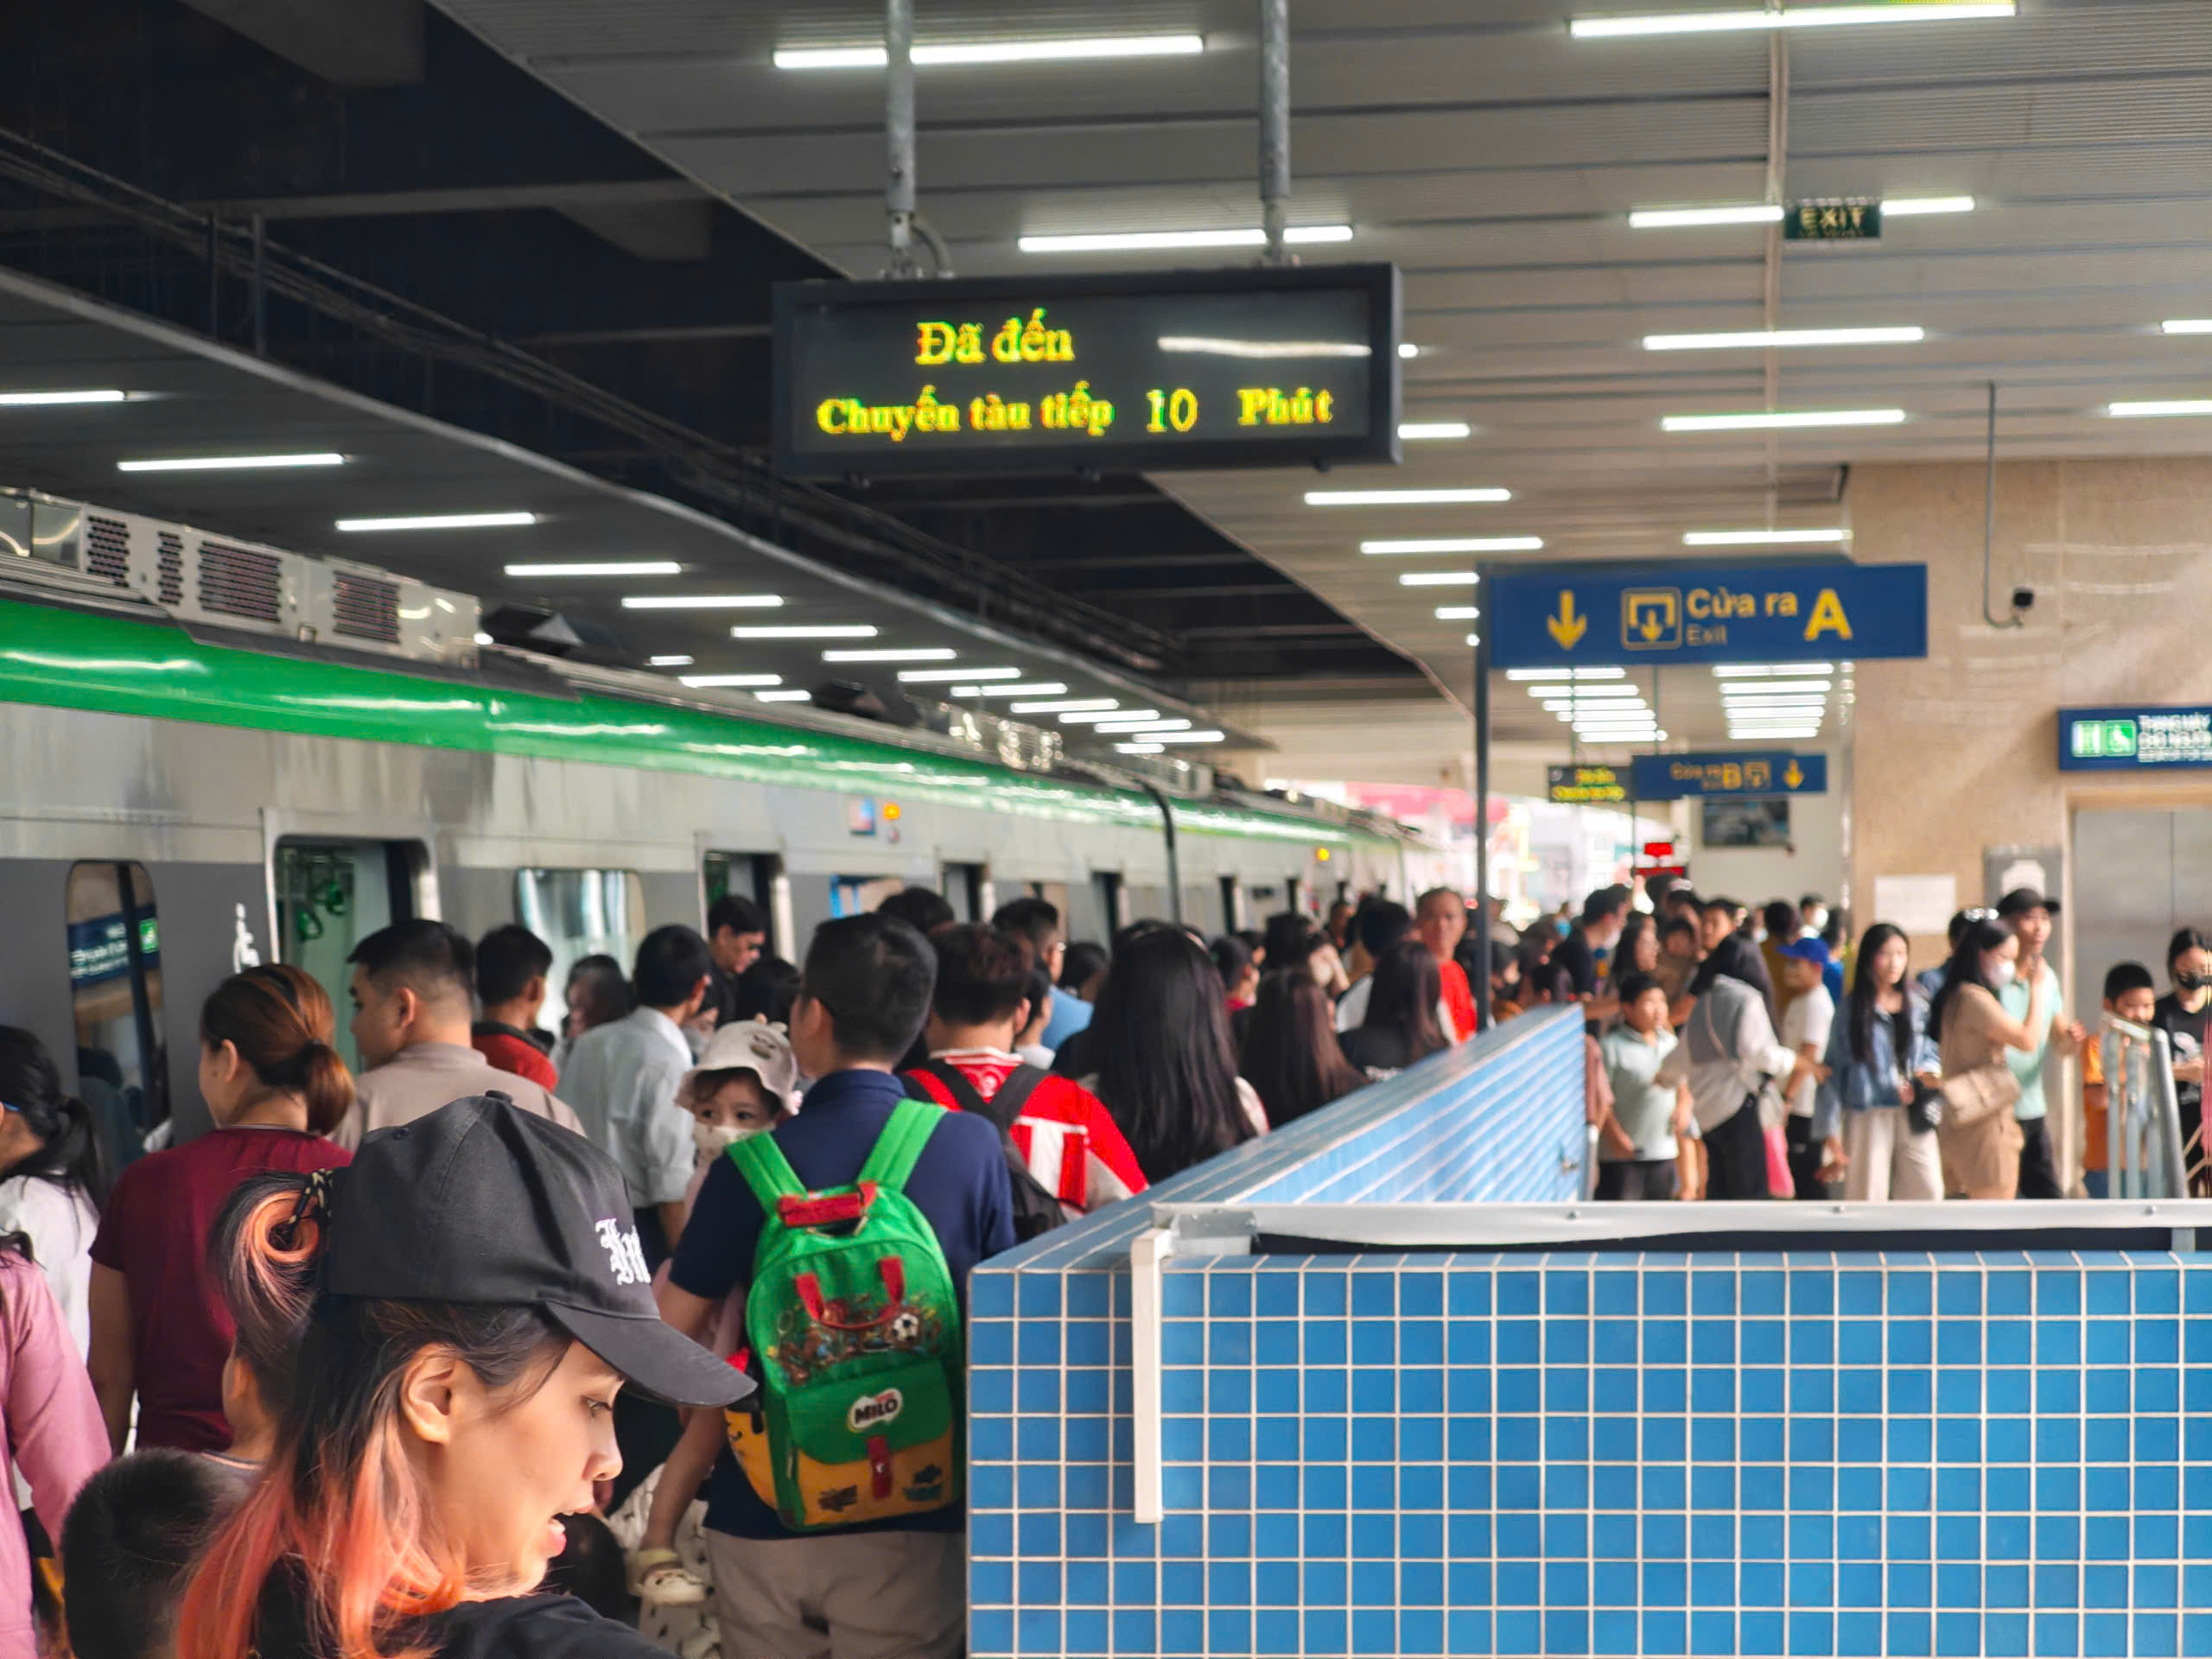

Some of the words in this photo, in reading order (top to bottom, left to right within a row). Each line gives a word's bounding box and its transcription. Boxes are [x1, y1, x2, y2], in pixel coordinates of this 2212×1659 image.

[1800, 207, 1865, 229] EXIT
[915, 321, 987, 366] Đã
[992, 308, 1076, 364] đến
[816, 385, 961, 442] Chuyến
[969, 393, 1033, 432] tàu
[1039, 380, 1116, 437] tiếp
[1147, 388, 1198, 433] 10
[1237, 387, 1334, 427] Phút
[1764, 591, 1798, 618] ra
[1803, 587, 1853, 642] A
[855, 1398, 899, 1426] MILO
